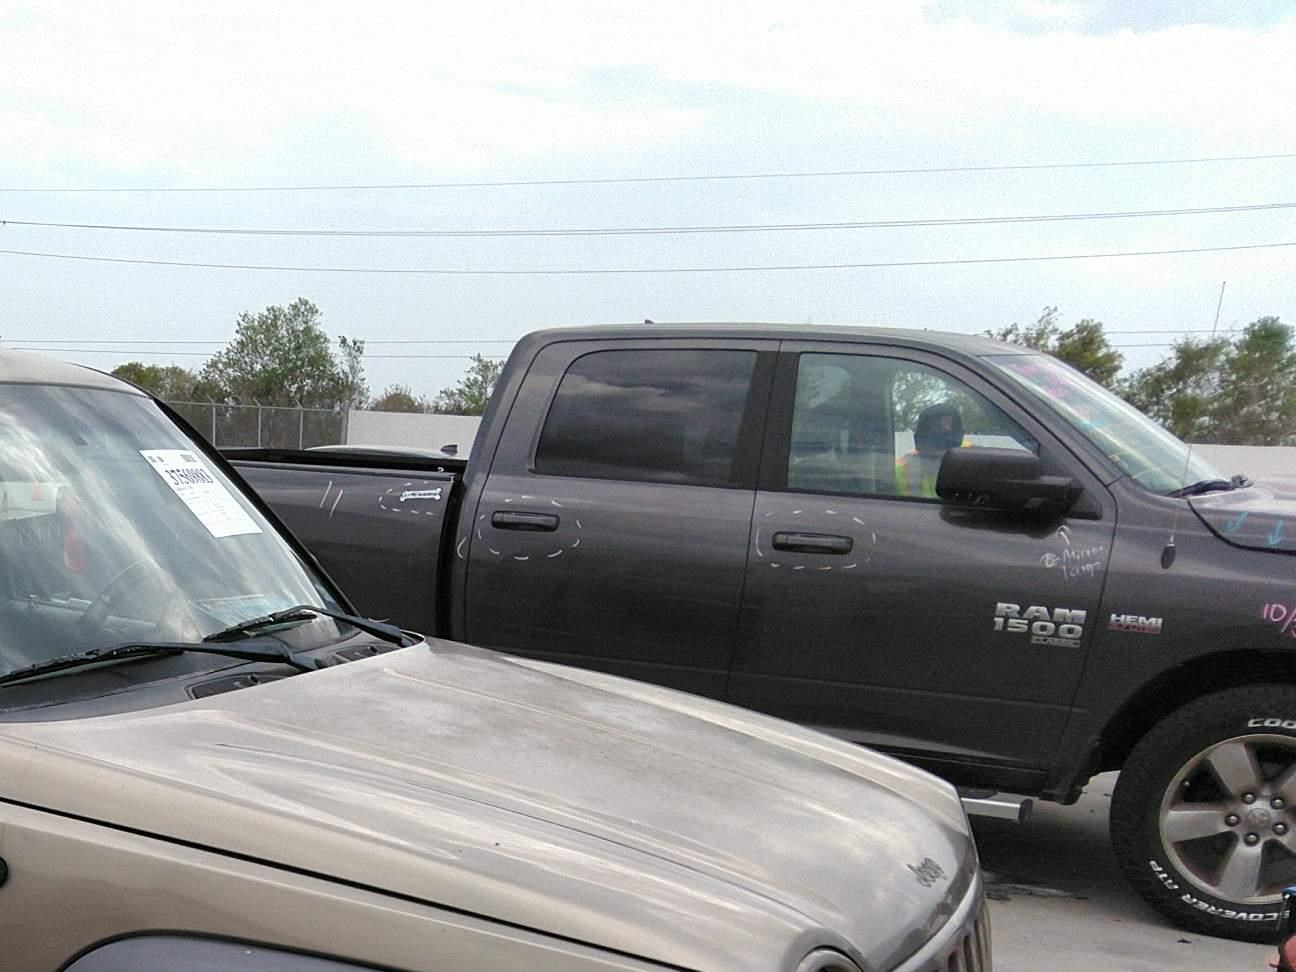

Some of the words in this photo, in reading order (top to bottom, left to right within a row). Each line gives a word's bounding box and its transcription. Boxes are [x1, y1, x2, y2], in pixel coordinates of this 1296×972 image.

[996, 602, 1087, 624] RAM
[1109, 613, 1163, 626] HEMI
[993, 617, 1083, 638] 1500
